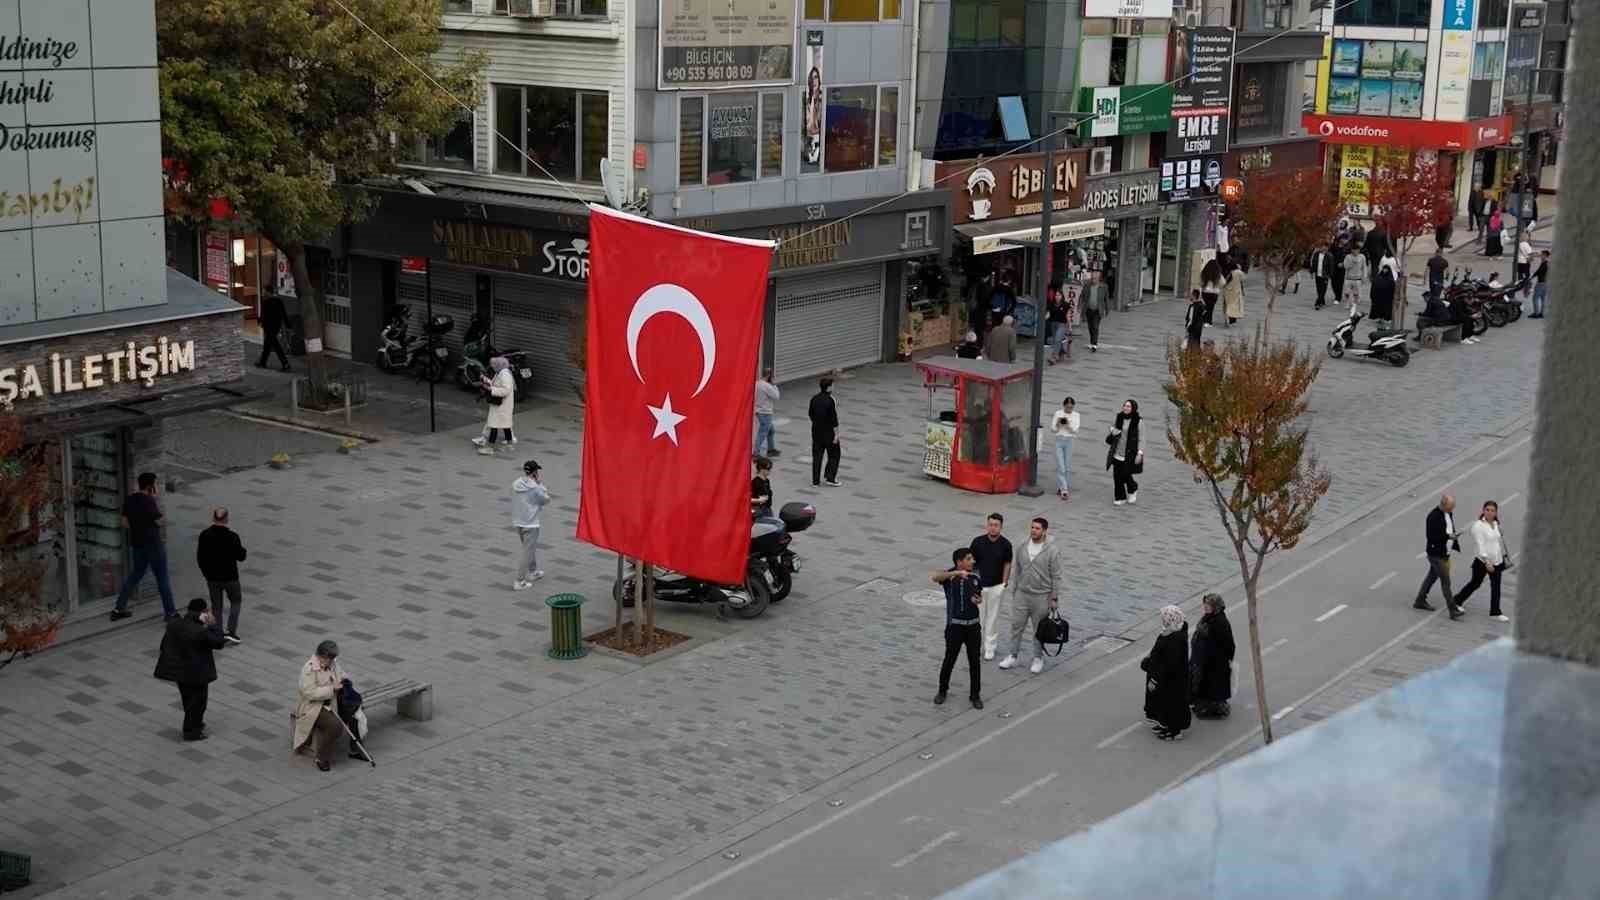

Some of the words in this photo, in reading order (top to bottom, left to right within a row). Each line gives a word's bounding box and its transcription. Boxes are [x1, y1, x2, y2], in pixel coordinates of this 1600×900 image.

[686, 47, 711, 64] BİLGİ
[666, 66, 686, 80] +90
[688, 66, 706, 80] 535
[707, 66, 725, 79] 961
[726, 65, 738, 80] 08
[740, 64, 753, 79] 09
[1178, 115, 1220, 138] EMRE
[1337, 126, 1389, 137] vodafone
[1184, 138, 1211, 154] İLETİŞİM
[1011, 157, 1078, 200] İŞBİEN
[1120, 180, 1159, 206] İLETİŞİM
[0, 365, 44, 411] ŞA
[52, 336, 196, 388] İLETİŞİM
